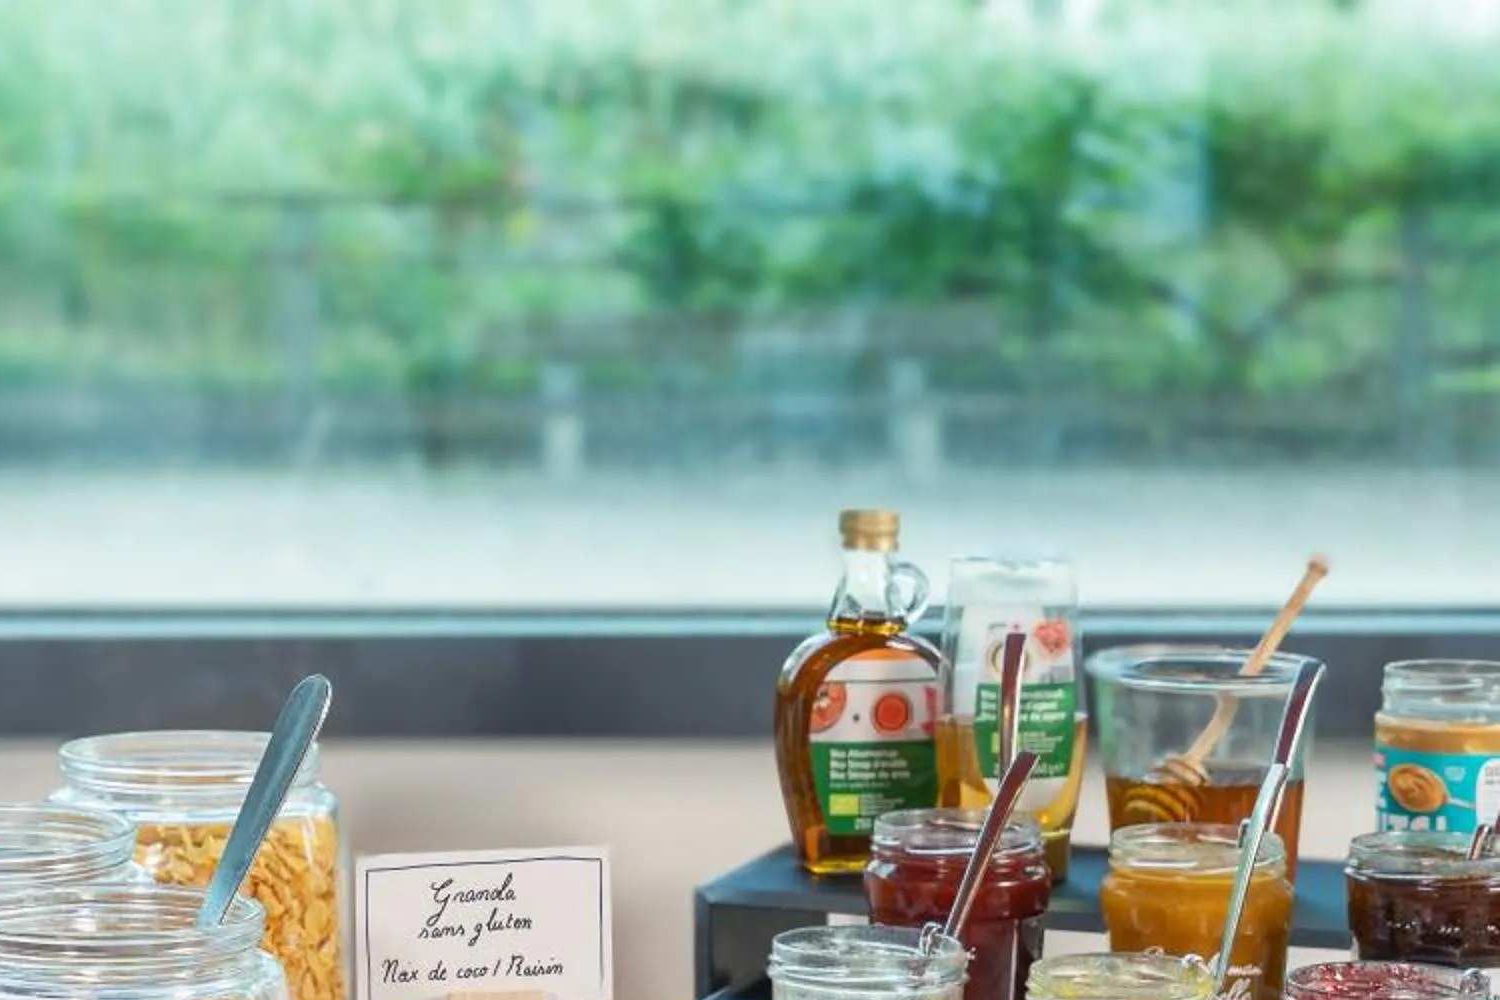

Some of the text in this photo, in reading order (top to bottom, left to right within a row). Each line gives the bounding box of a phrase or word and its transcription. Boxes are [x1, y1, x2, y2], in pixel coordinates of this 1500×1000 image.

[426, 871, 517, 927] Granola
[418, 907, 533, 946] sans gluten
[382, 958, 419, 983] Noix
[428, 960, 447, 980] de
[456, 966, 489, 979] coco
[506, 954, 564, 977] Raisin
